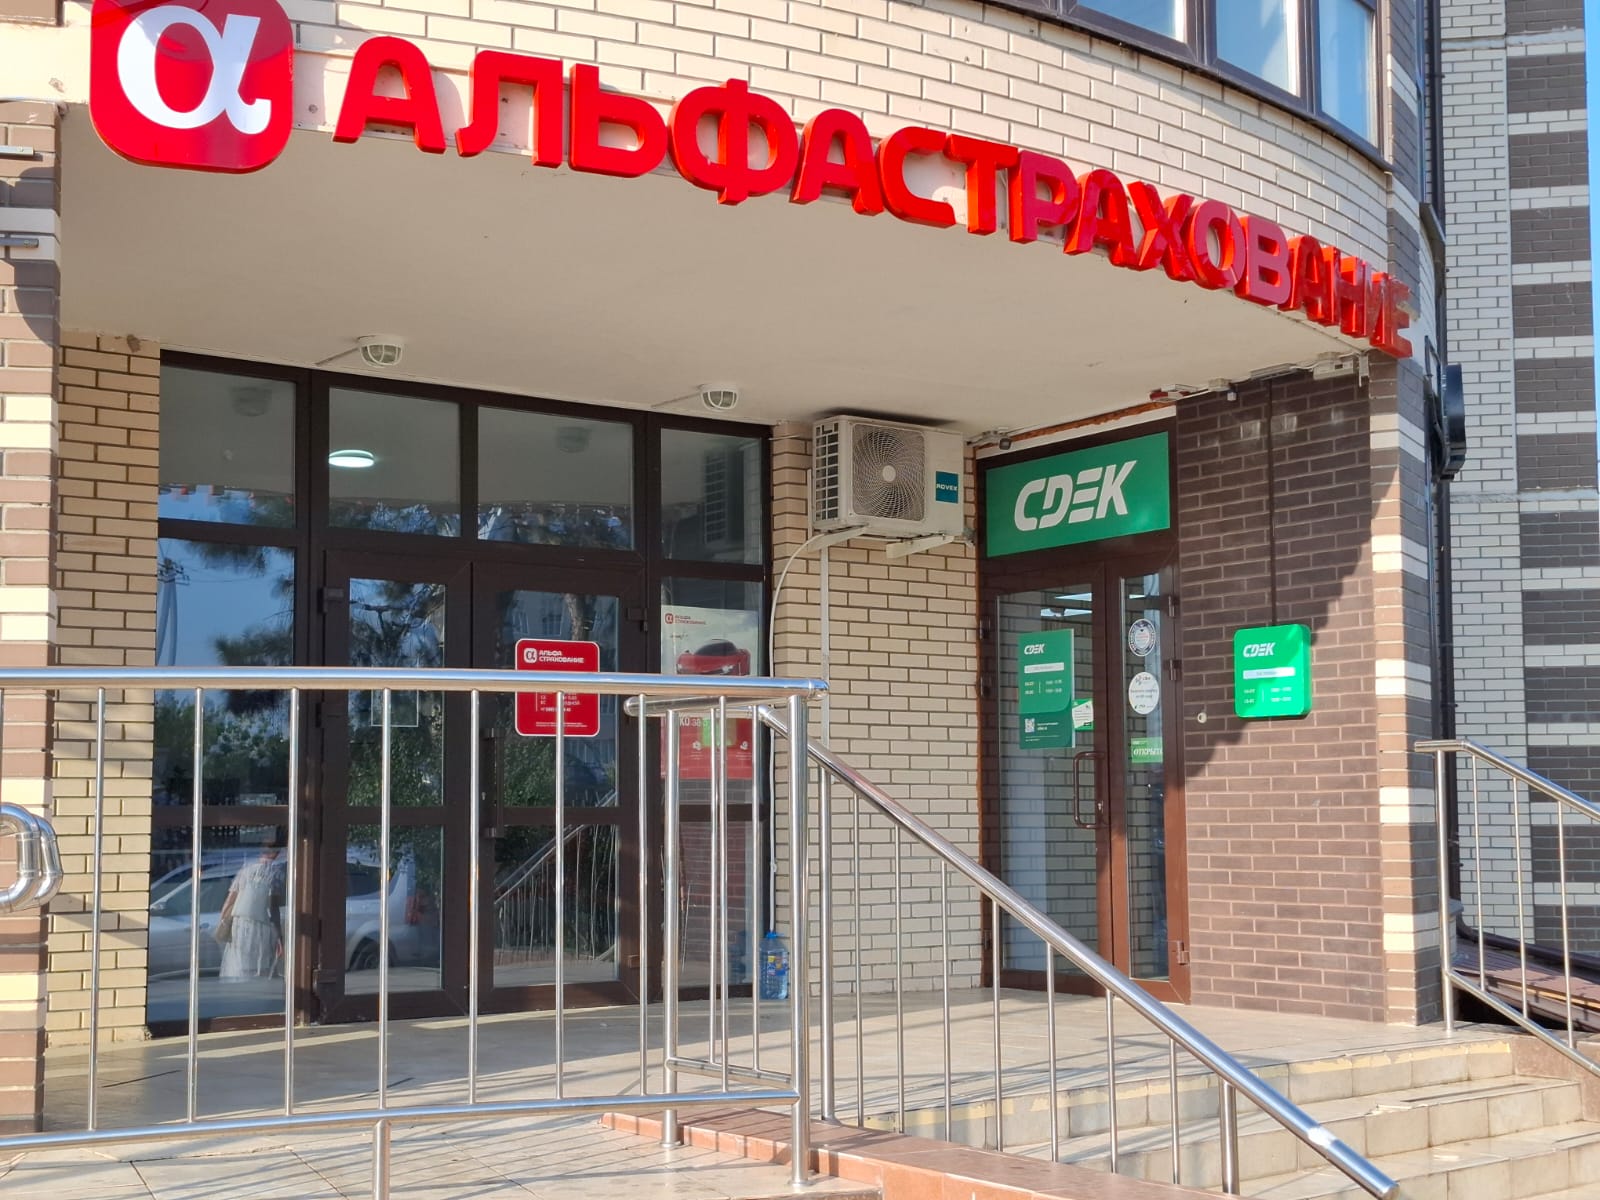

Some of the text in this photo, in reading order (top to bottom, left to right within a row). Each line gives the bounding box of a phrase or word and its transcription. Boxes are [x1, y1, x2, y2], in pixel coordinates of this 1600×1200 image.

[332, 36, 1412, 358] АЛЬФАСТРАХОВАНИЕ
[1014, 459, 1137, 532] CDEK
[1024, 643, 1045, 655] CDEK
[1243, 642, 1276, 658] CDEK
